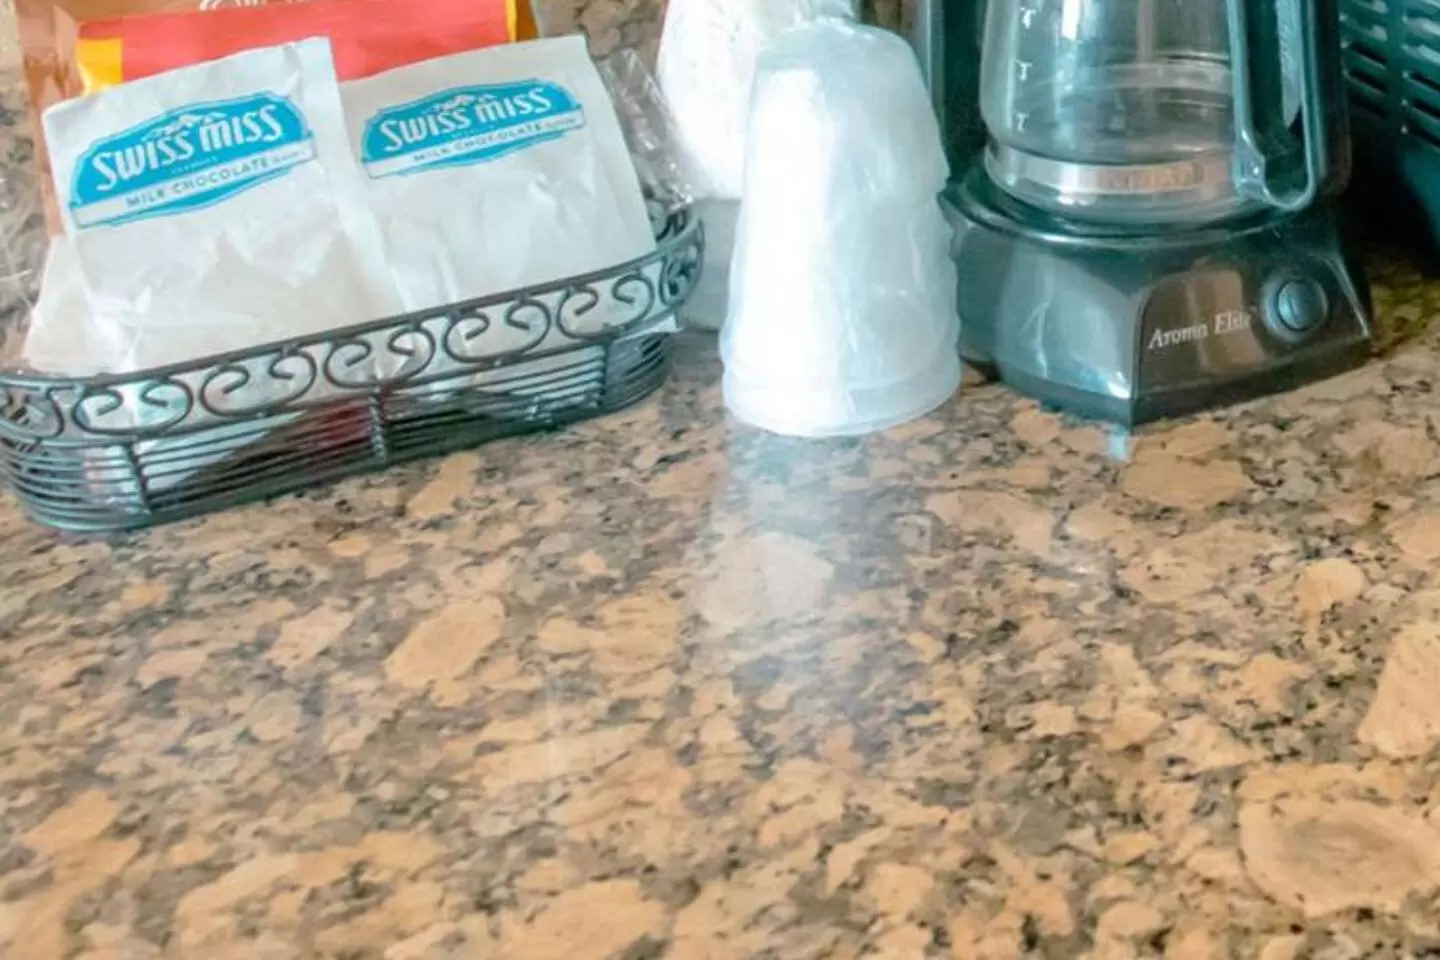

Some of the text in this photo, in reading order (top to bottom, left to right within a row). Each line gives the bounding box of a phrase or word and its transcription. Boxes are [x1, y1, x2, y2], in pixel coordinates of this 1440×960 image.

[92, 104, 284, 191] SWISS MISS
[379, 87, 552, 152] SWISS MISS
[126, 186, 166, 208] MILK
[172, 156, 270, 195] CHOCOLATE
[1148, 323, 1208, 349] Aroma
